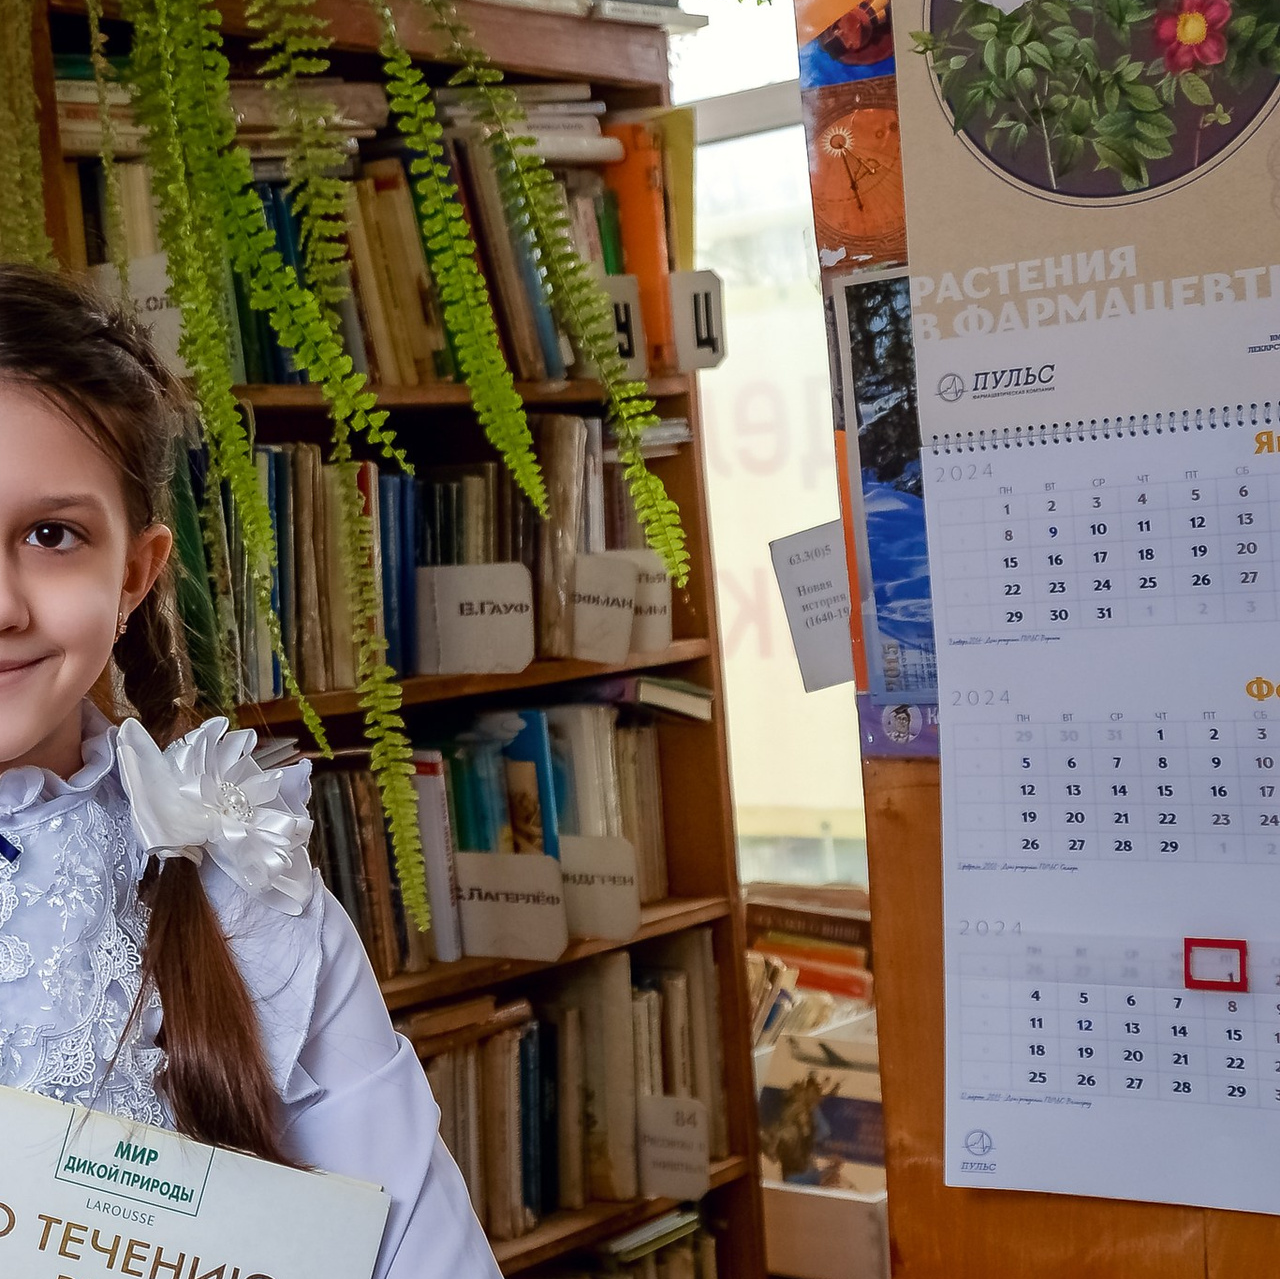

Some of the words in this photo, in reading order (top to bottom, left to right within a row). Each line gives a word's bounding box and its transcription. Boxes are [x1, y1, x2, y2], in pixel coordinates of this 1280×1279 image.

[910, 245, 1138, 308] РАСТЕНИЯ
[953, 265, 1280, 338] ФАРМАЦЕВТ
[613, 302, 636, 359] У
[693, 292, 719, 354] Ц
[972, 364, 1056, 392] ПУЛЬС
[935, 462, 995, 483] 2024
[999, 486, 1013, 495] ПН
[1044, 482, 1056, 492] ВТ
[1092, 478, 1106, 488] СР
[1137, 474, 1149, 483] ЧТ
[1185, 470, 1198, 479] ПТ
[1235, 465, 1250, 476] СБ
[1003, 504, 1010, 515] 1
[1047, 500, 1057, 512] 2
[1092, 496, 1102, 509] 3
[1137, 493, 1148, 505] 4
[1191, 489, 1201, 501] 5
[1238, 485, 1249, 498] 6
[1004, 529, 1014, 542] 8
[1048, 526, 1058, 538] 9
[1090, 523, 1107, 536] 10
[1137, 520, 1151, 532] 11
[1189, 516, 1206, 529] 12
[1237, 512, 1254, 526] 13
[788, 544, 833, 567] 63.3(0)5
[1003, 556, 1019, 569] 15
[1047, 554, 1064, 566] 16
[1093, 551, 1108, 563] 17
[1138, 548, 1155, 561] 18
[1191, 544, 1208, 558] 19
[1236, 541, 1258, 555] 20
[796, 580, 833, 598] Новая
[1004, 583, 1022, 596] 22
[1048, 581, 1066, 594] 23
[1093, 579, 1112, 592] 24
[1139, 576, 1158, 589] 25
[1191, 573, 1211, 587] 26
[1240, 571, 1259, 584] 27
[801, 592, 848, 613] история
[805, 606, 851, 630] (1640-19
[1006, 611, 1023, 623] 29
[1050, 609, 1069, 621] 30
[1096, 607, 1112, 619] 31
[951, 689, 1011, 707] 2024
[1016, 713, 1031, 723] ПН
[1062, 713, 1073, 722] ВТ
[1109, 712, 1124, 722] СР
[1155, 712, 1167, 720] ЧТ
[1203, 711, 1216, 720] ПТ
[1253, 710, 1268, 720] СБ
[1156, 729, 1164, 741] 1
[1209, 728, 1220, 740] 2
[1257, 728, 1267, 740] 3
[1022, 757, 1031, 769] 5
[1067, 757, 1077, 769] 6
[1112, 757, 1122, 769] 7
[1158, 756, 1168, 769] 8
[1211, 756, 1222, 769] 9
[1255, 756, 1274, 769] 10
[1020, 784, 1036, 796] 12
[1065, 784, 1082, 796] 13
[1111, 784, 1128, 797] 14
[1157, 785, 1174, 797] 15
[1210, 785, 1228, 798] 16
[1259, 785, 1275, 798] 17
[1021, 811, 1037, 823] 19
[1065, 811, 1086, 824] 20
[1113, 812, 1129, 824] 21
[1158, 812, 1177, 825] 22
[1211, 813, 1231, 826] 23
[1259, 814, 1280, 827] 24
[1021, 838, 1040, 851] 26
[1068, 839, 1086, 851] 27
[1114, 839, 1133, 852] 28
[1160, 840, 1179, 853] 29
[958, 919, 1023, 937] 2024
[1030, 990, 1041, 1002] 4
[1079, 992, 1089, 1004] 5
[1126, 994, 1136, 1007] 6
[1173, 997, 1183, 1009] 7
[1227, 1000, 1238, 1013] 8
[1029, 1017, 1043, 1029] 11
[1076, 1019, 1093, 1032] 12
[1124, 1022, 1141, 1035] 13
[1170, 1025, 1189, 1038] 14
[1225, 1029, 1243, 1042] 15
[1028, 1044, 1046, 1057] 18
[1077, 1047, 1094, 1059] 19
[1123, 1049, 1144, 1062] 20
[1172, 1052, 1189, 1066] 21
[1226, 1056, 1245, 1070] 22
[1028, 1071, 1047, 1084] 25
[1077, 1074, 1096, 1087] 26
[1126, 1077, 1144, 1090] 27
[1172, 1080, 1192, 1094] 28
[1227, 1085, 1247, 1098] 29
[114, 1140, 160, 1167] МИР
[960, 1161, 997, 1172] ПУЛЬС
[63, 1155, 120, 1183] ДИКОЙ
[120, 1172, 195, 1204] ПРИРОДЫ
[86, 1197, 156, 1227] LAROUSSE
